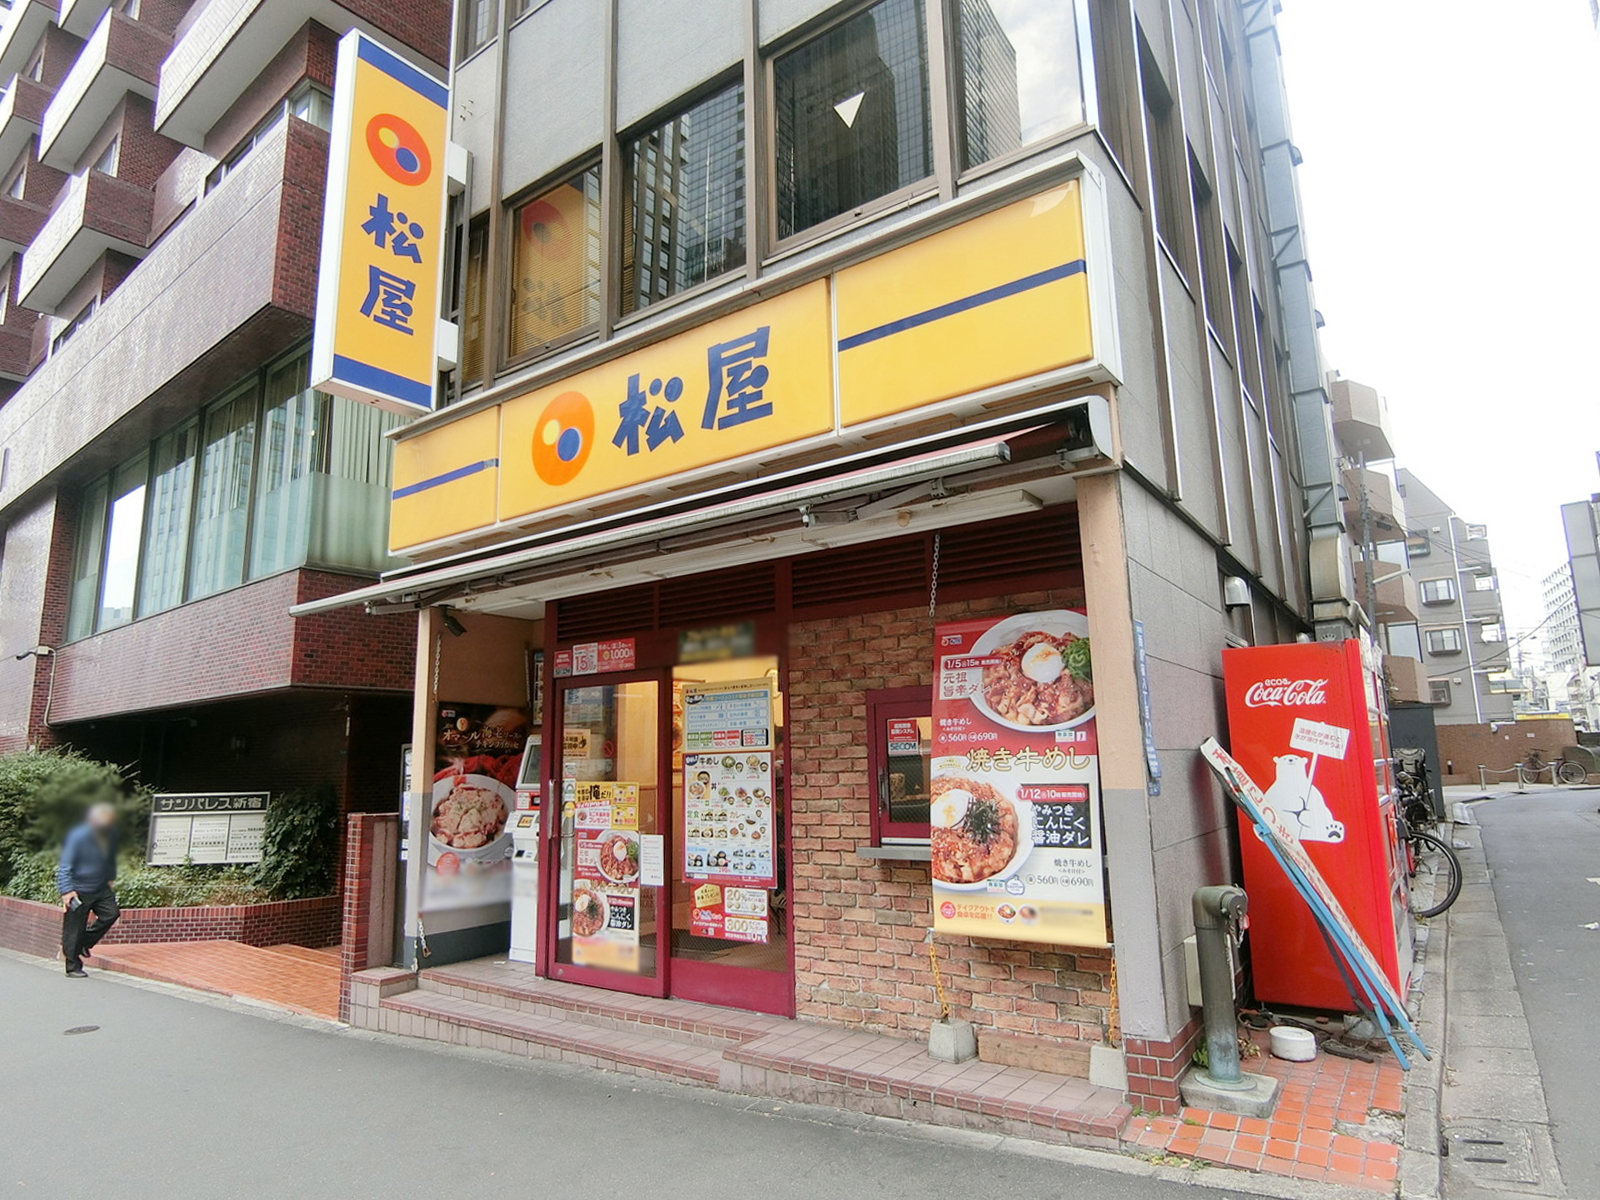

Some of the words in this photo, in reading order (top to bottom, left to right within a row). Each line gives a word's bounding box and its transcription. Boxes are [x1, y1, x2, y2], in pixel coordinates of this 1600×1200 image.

[360, 193, 424, 336] 松屋
[612, 326, 773, 456] 松屋
[944, 671, 967, 684] 元祖
[943, 683, 992, 698] 旨辛ダレ
[1245, 679, 1328, 708] Coca-Cola
[890, 742, 917, 751] SECOM
[699, 755, 719, 766] 牛めし
[965, 746, 1090, 772] 焼き牛めし
[160, 797, 262, 811] サンパレス新宿
[1031, 804, 1074, 816] やみつき
[1031, 816, 1086, 830] にんにく
[1031, 830, 1090, 846] 醤油ダレ
[1053, 858, 1092, 868] 焼き牛めし
[727, 919, 748, 932] 300
